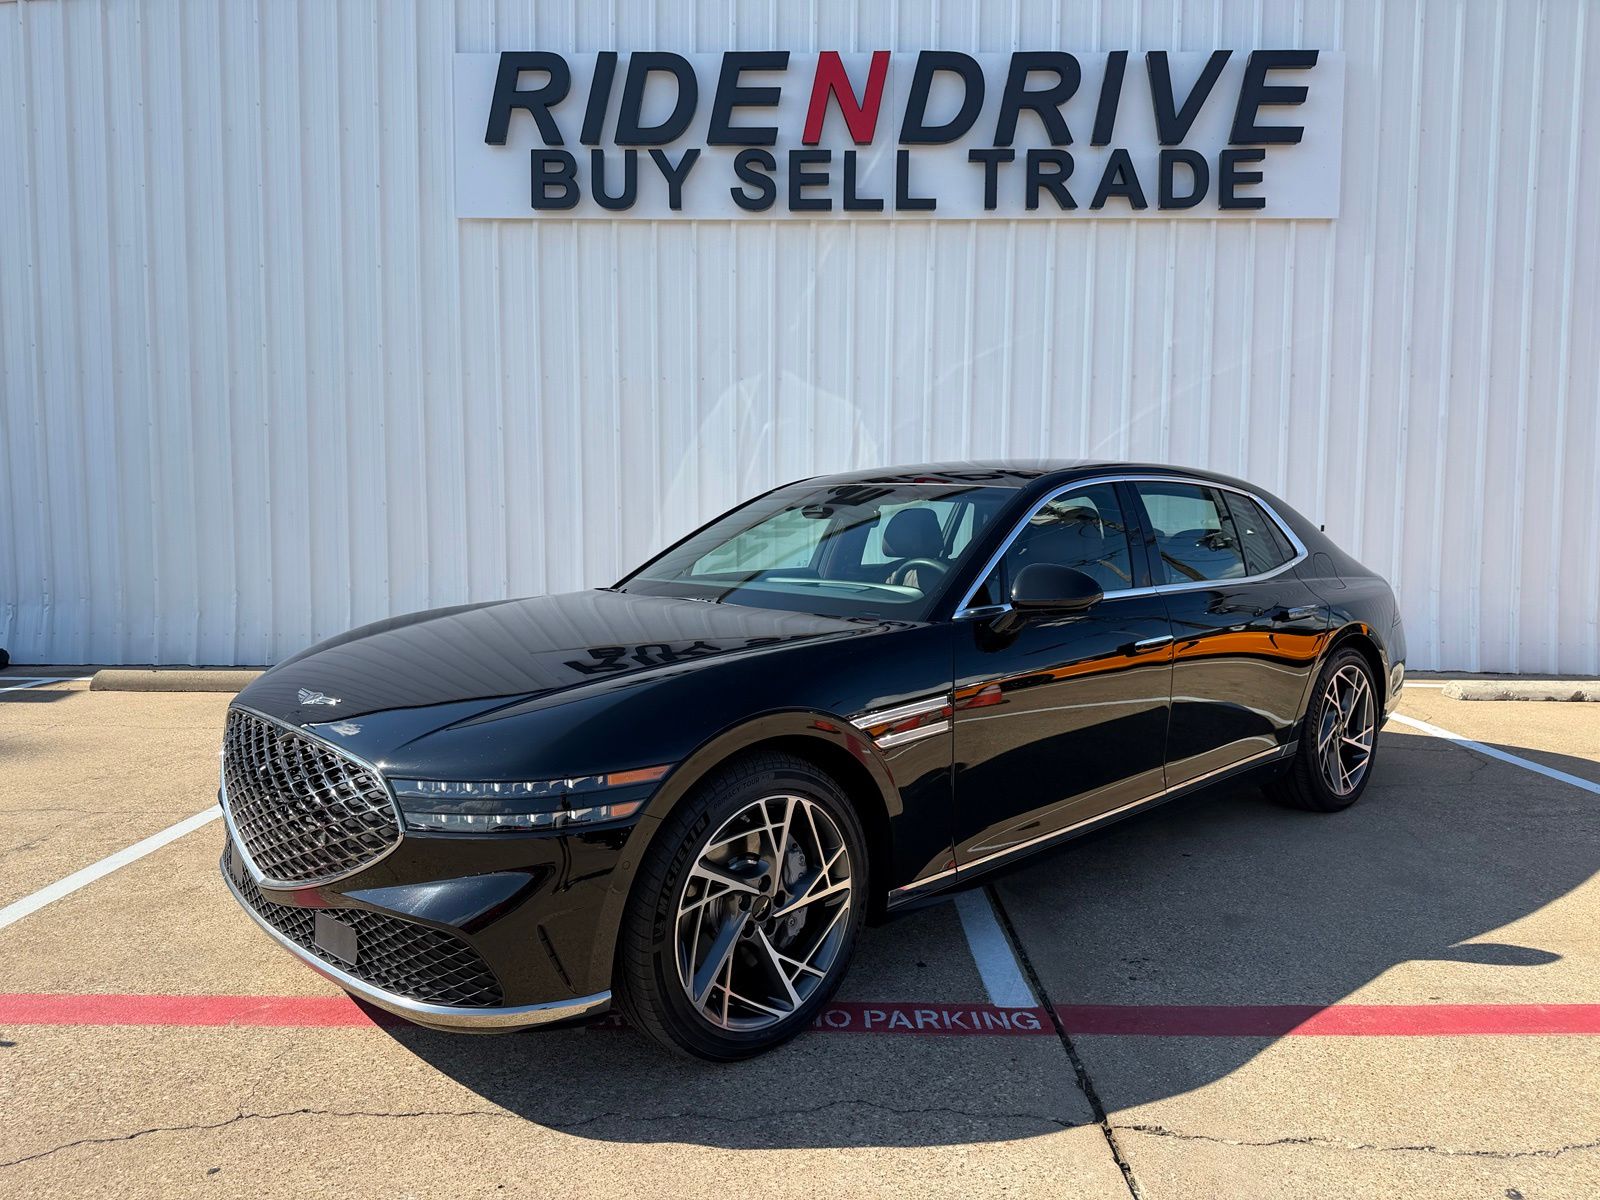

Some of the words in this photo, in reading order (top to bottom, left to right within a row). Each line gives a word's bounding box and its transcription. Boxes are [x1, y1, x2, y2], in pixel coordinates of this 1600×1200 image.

[531, 149, 700, 211] BUY
[730, 148, 936, 212] SELL
[968, 148, 1266, 211] TRADE
[656, 810, 710, 914] MICHELIN
[863, 1009, 1042, 1030] PARKING
